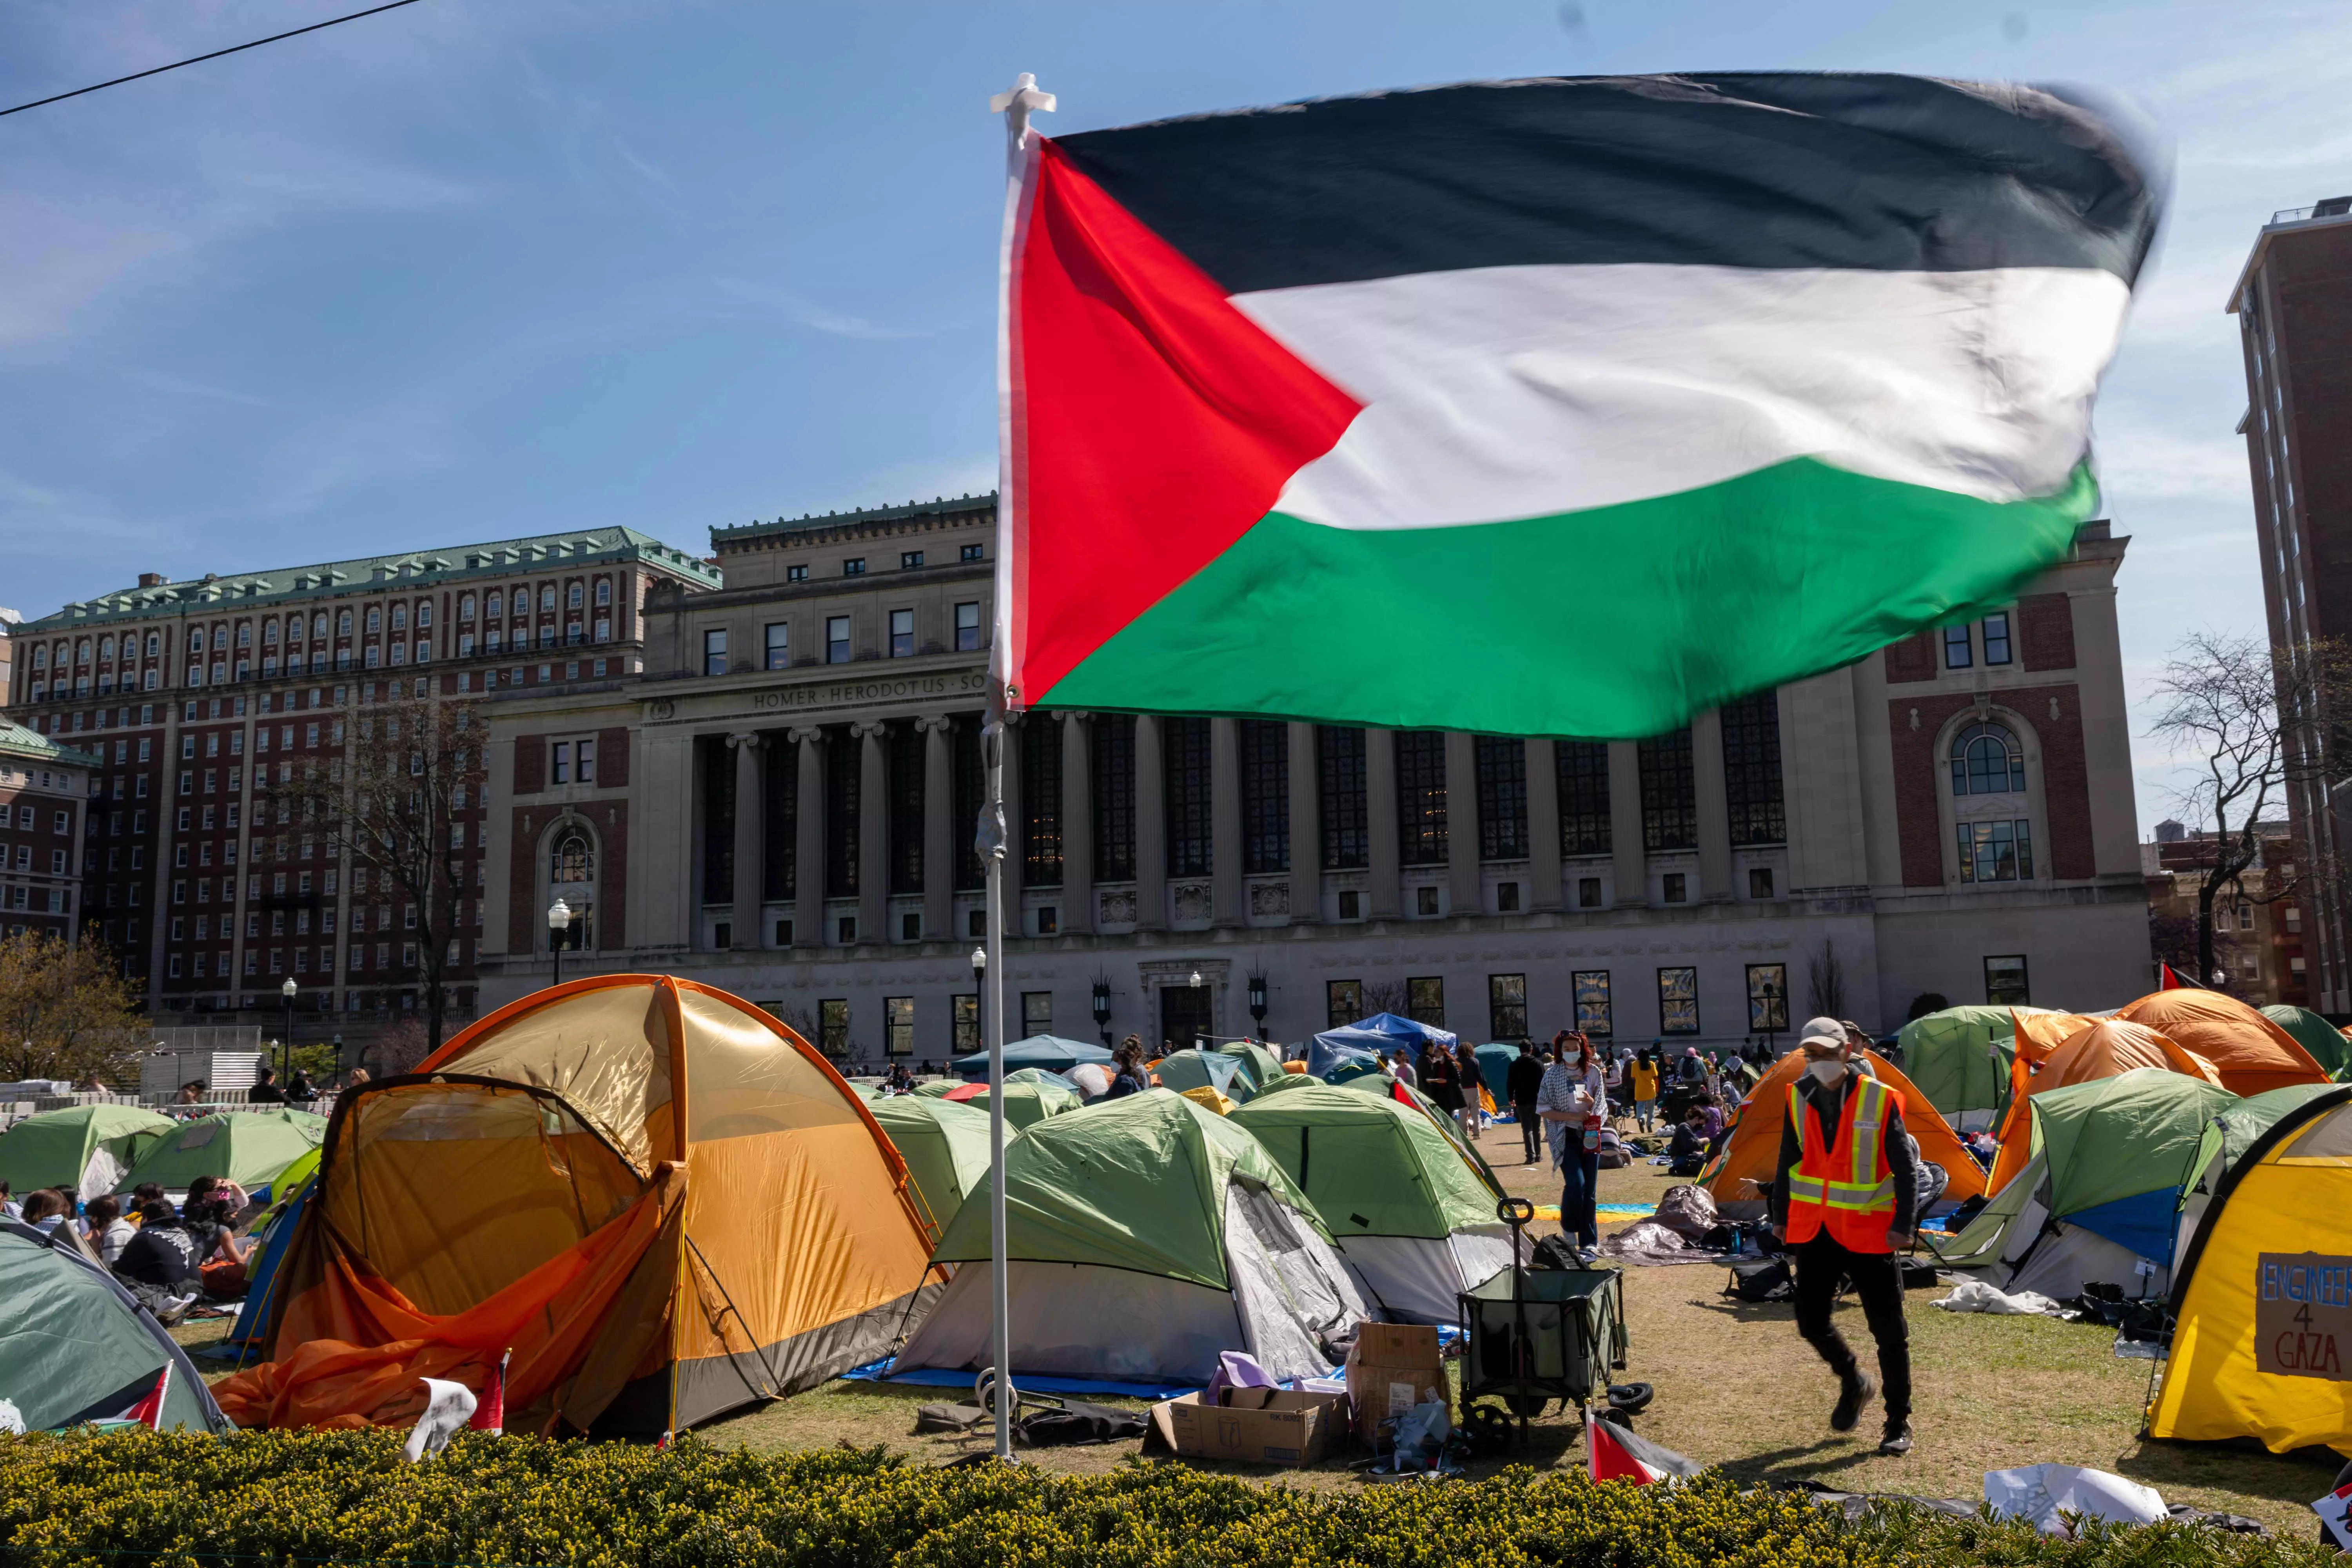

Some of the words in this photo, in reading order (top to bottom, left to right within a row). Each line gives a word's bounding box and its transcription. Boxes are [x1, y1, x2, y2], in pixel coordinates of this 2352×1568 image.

[754, 691, 817, 708] HOMER
[830, 678, 944, 702] HERODOTUS
[2293, 1303, 2313, 1332] 4
[2276, 1331, 2341, 1373] GAZA
